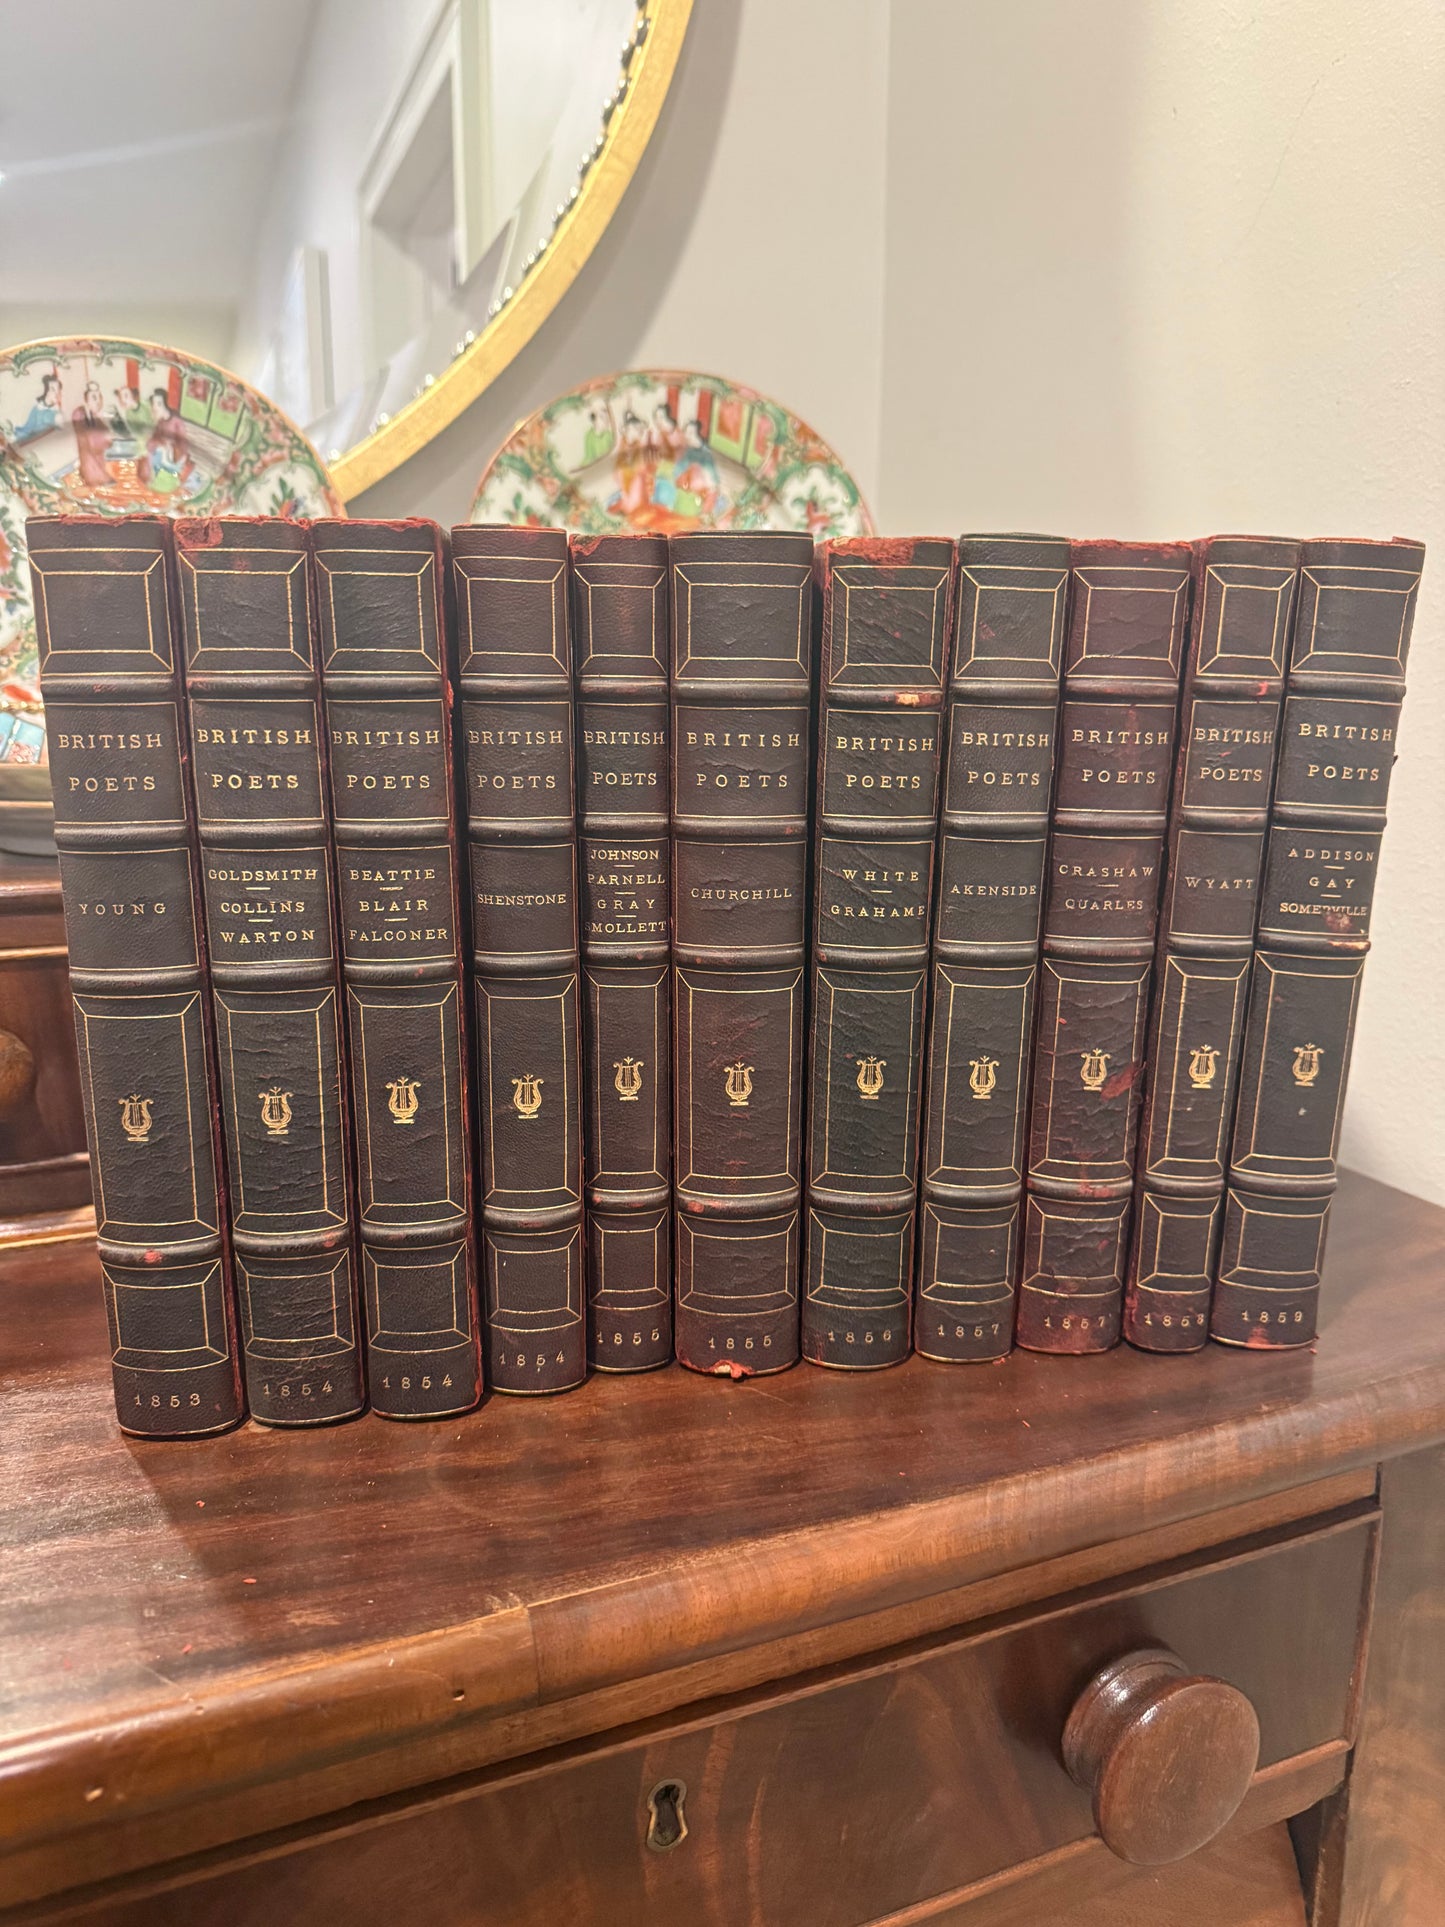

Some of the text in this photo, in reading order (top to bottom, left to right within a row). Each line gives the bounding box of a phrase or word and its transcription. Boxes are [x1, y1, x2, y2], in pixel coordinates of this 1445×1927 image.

[197, 729, 311, 745] BRITISH
[333, 730, 440, 745] BRITISH
[468, 730, 563, 745] BRITISH
[584, 731, 665, 745] BRITISH
[687, 732, 800, 747] BRITISH
[1072, 729, 1168, 745] BRITISH
[1194, 728, 1273, 744] BRITISH
[1298, 723, 1393, 742] BRITISH
[58, 733, 163, 749] BRITISH
[836, 736, 934, 751] BRITISH
[962, 732, 1049, 748] BRITISH
[593, 772, 657, 785] POETS
[968, 772, 1040, 786] POETS
[1081, 769, 1155, 784] POETS
[1200, 767, 1262, 782] POETS
[1308, 765, 1379, 781] POETS
[69, 776, 156, 792] POETS
[211, 774, 299, 790] POETS
[347, 775, 430, 790] POETS
[477, 775, 556, 789] POETS
[697, 774, 788, 788] POETS
[846, 775, 920, 789] POETS
[591, 850, 659, 861] JOHNSON
[1288, 848, 1374, 862] ADDISON
[208, 869, 318, 881] GOLDSMITH
[350, 869, 435, 881] BEATTIE
[843, 869, 919, 881] WHITE
[1059, 865, 1154, 877] CRASHAW
[587, 874, 665, 885] PARNELL
[1185, 876, 1253, 889] WYATT
[1309, 877, 1355, 889] GAY
[691, 888, 792, 900] CHURCHILL
[951, 885, 1036, 896] AKENSIDE
[221, 901, 305, 913] COLLINS
[359, 900, 429, 912] BLAIR
[477, 894, 566, 906] SHENSTONE
[597, 900, 655, 909] GRAY
[1065, 898, 1143, 910] QUARLES
[79, 903, 166, 915] YOUNG
[831, 905, 925, 917] GRAHAME
[585, 922, 666, 933] SMOLLETT
[220, 930, 315, 943] WARTON
[350, 929, 448, 942] FALCONER
[1044, 1316, 1105, 1329] 1857
[1242, 1311, 1302, 1323] 1859
[596, 1330, 660, 1345] 1855
[828, 1330, 891, 1343] 1856
[938, 1324, 999, 1337] 1857
[709, 1336, 772, 1349] 1855
[500, 1351, 564, 1366] 1854
[383, 1373, 453, 1389] 1854
[263, 1380, 333, 1397] 1854
[134, 1393, 201, 1408] 1853
